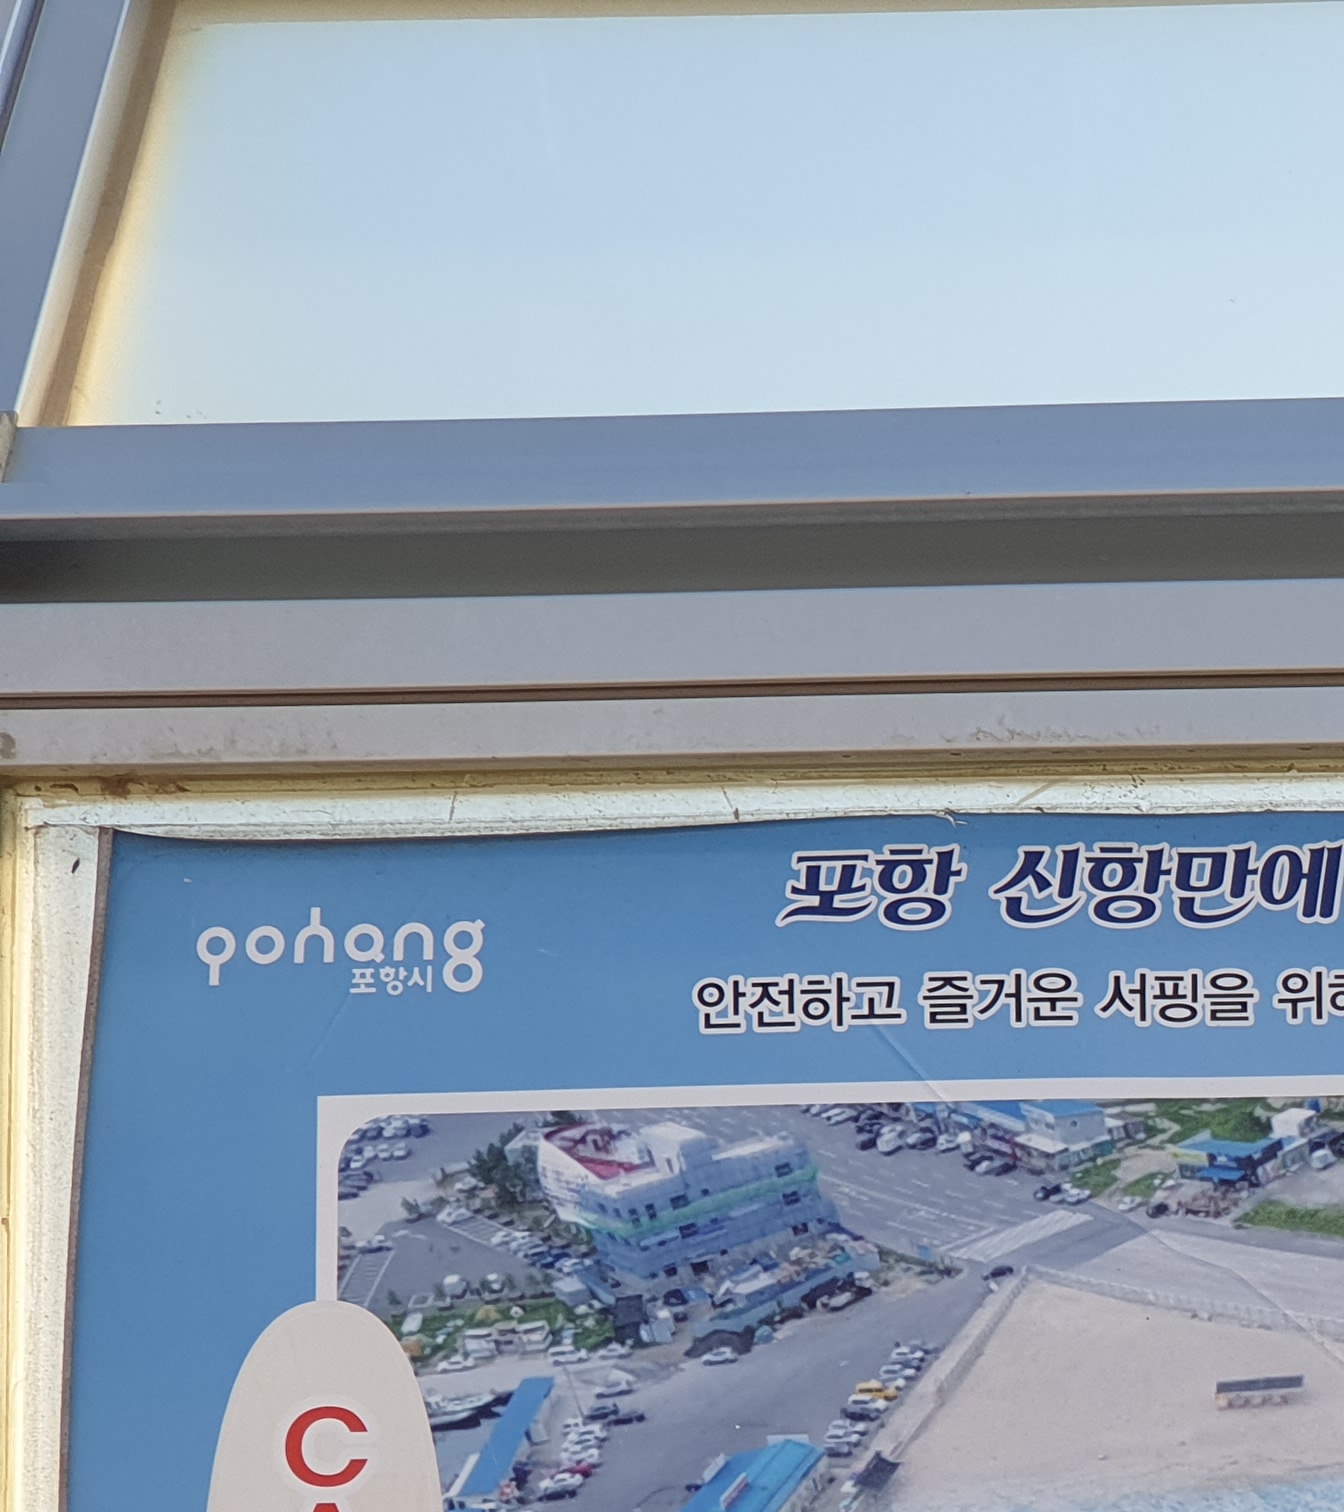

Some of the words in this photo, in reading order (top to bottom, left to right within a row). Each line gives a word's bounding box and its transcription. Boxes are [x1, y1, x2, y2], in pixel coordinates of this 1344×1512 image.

[777, 843, 966, 929] 포항
[349, 964, 433, 994] 포항시
[693, 975, 905, 1034] 안전하고
[920, 968, 1081, 1029] 즐거운
[1097, 966, 1256, 1026] 서핑을
